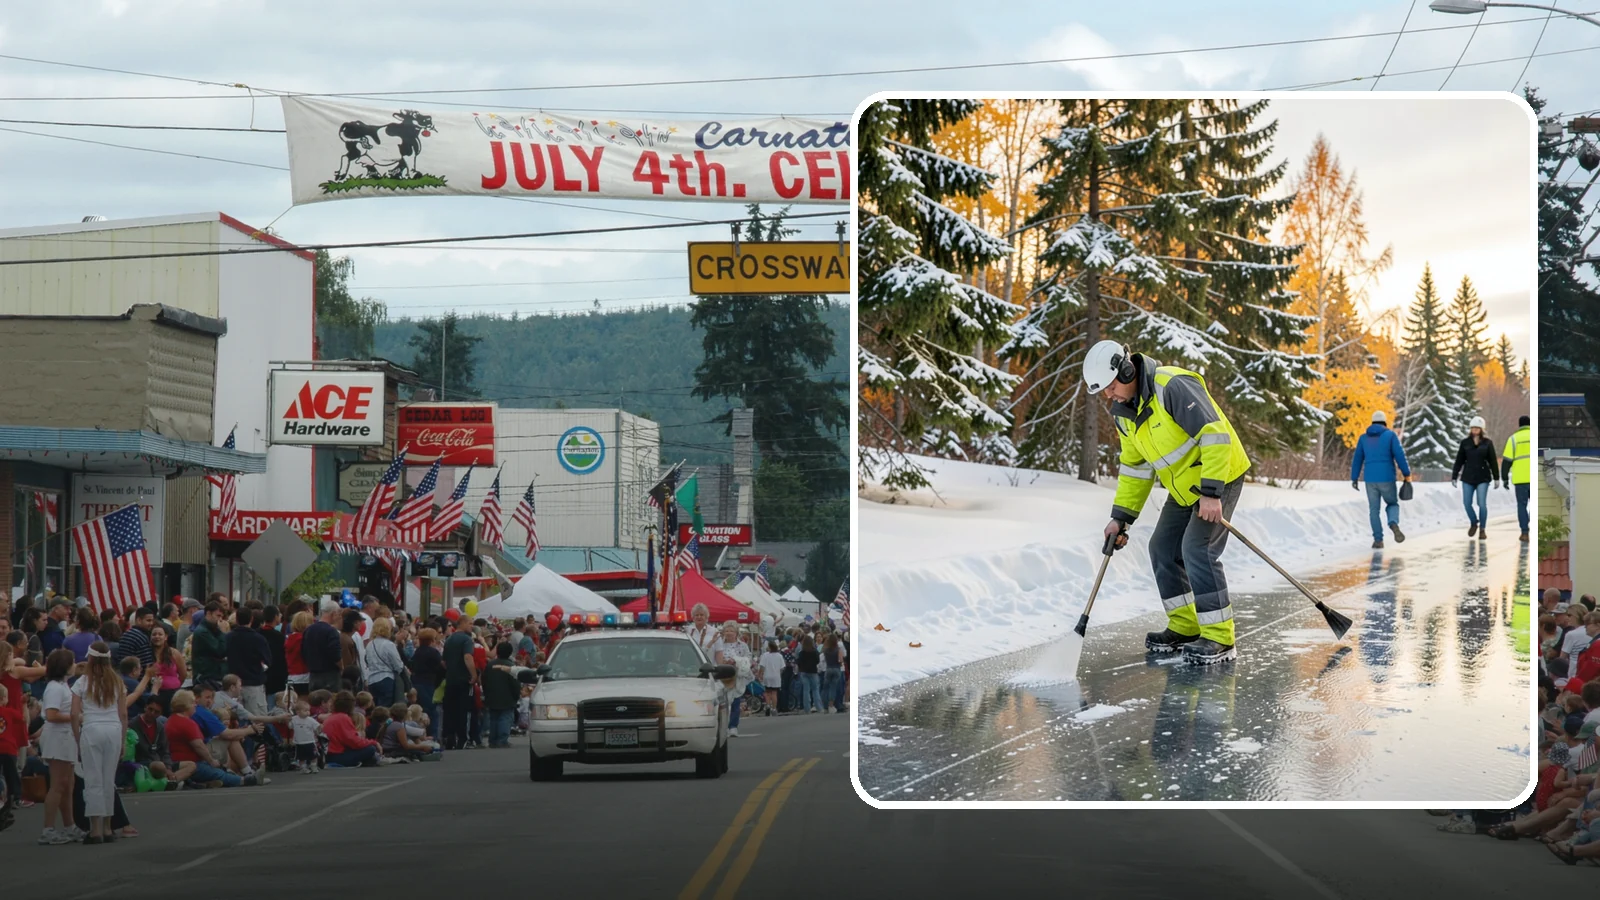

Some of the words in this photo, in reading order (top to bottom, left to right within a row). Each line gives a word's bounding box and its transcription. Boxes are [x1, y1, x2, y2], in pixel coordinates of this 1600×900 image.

[481, 141, 605, 192] JULY
[632, 150, 746, 197] 4th.
[697, 254, 850, 279] CROSSWA
[283, 380, 373, 419] ACE
[406, 409, 452, 421] CEDAR
[284, 421, 370, 436] Hardware
[416, 428, 477, 447] Coca-Cola
[354, 467, 384, 480] Simpl
[84, 485, 93, 494] St.
[95, 485, 124, 495] Vincent
[126, 486, 136, 495] de
[138, 486, 155, 495] Paul
[81, 504, 153, 522] THT
[212, 516, 330, 535] HARDARE
[688, 526, 741, 535] CRNATION
[699, 535, 730, 543] GLASS
